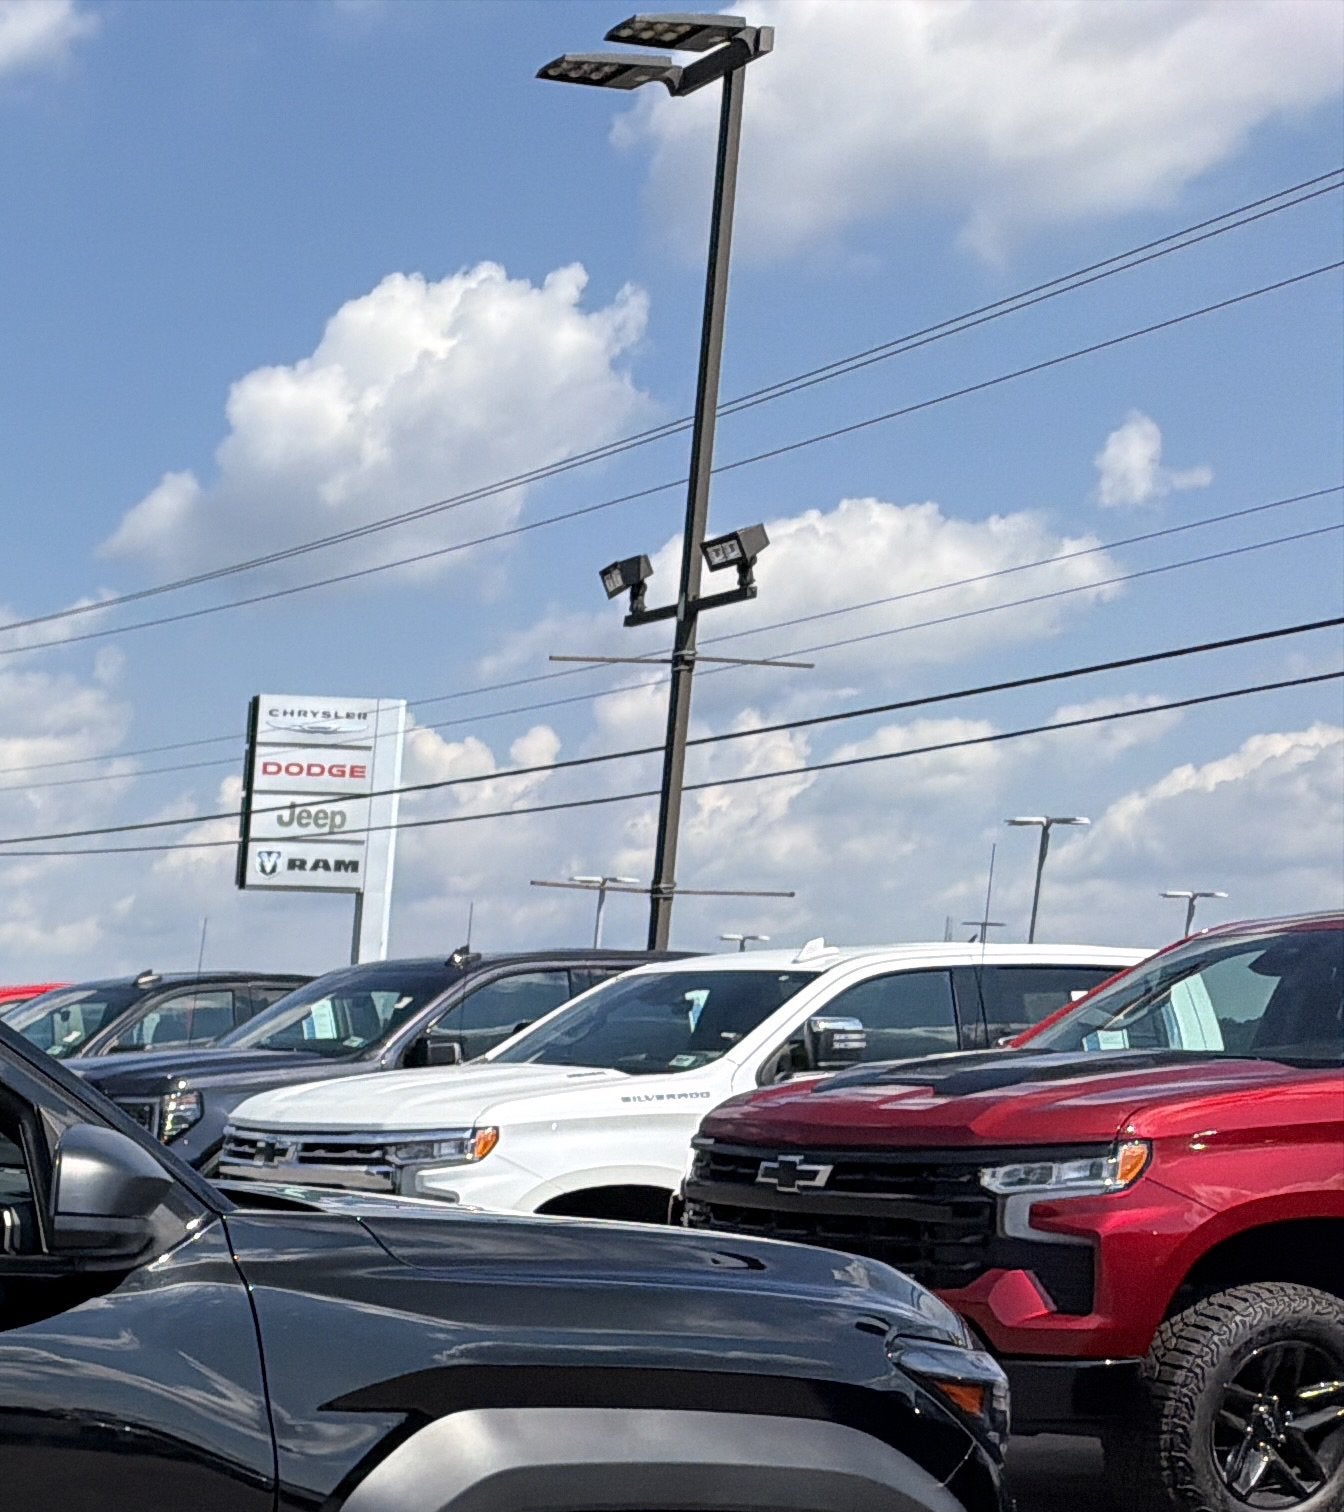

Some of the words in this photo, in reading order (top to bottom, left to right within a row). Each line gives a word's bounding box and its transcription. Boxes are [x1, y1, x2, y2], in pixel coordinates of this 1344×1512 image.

[268, 708, 368, 721] CHRYSLER
[262, 762, 366, 779] DODGE
[276, 801, 347, 833] Jeep
[286, 858, 359, 873] RAM
[621, 1091, 710, 1103] SILVERADO
